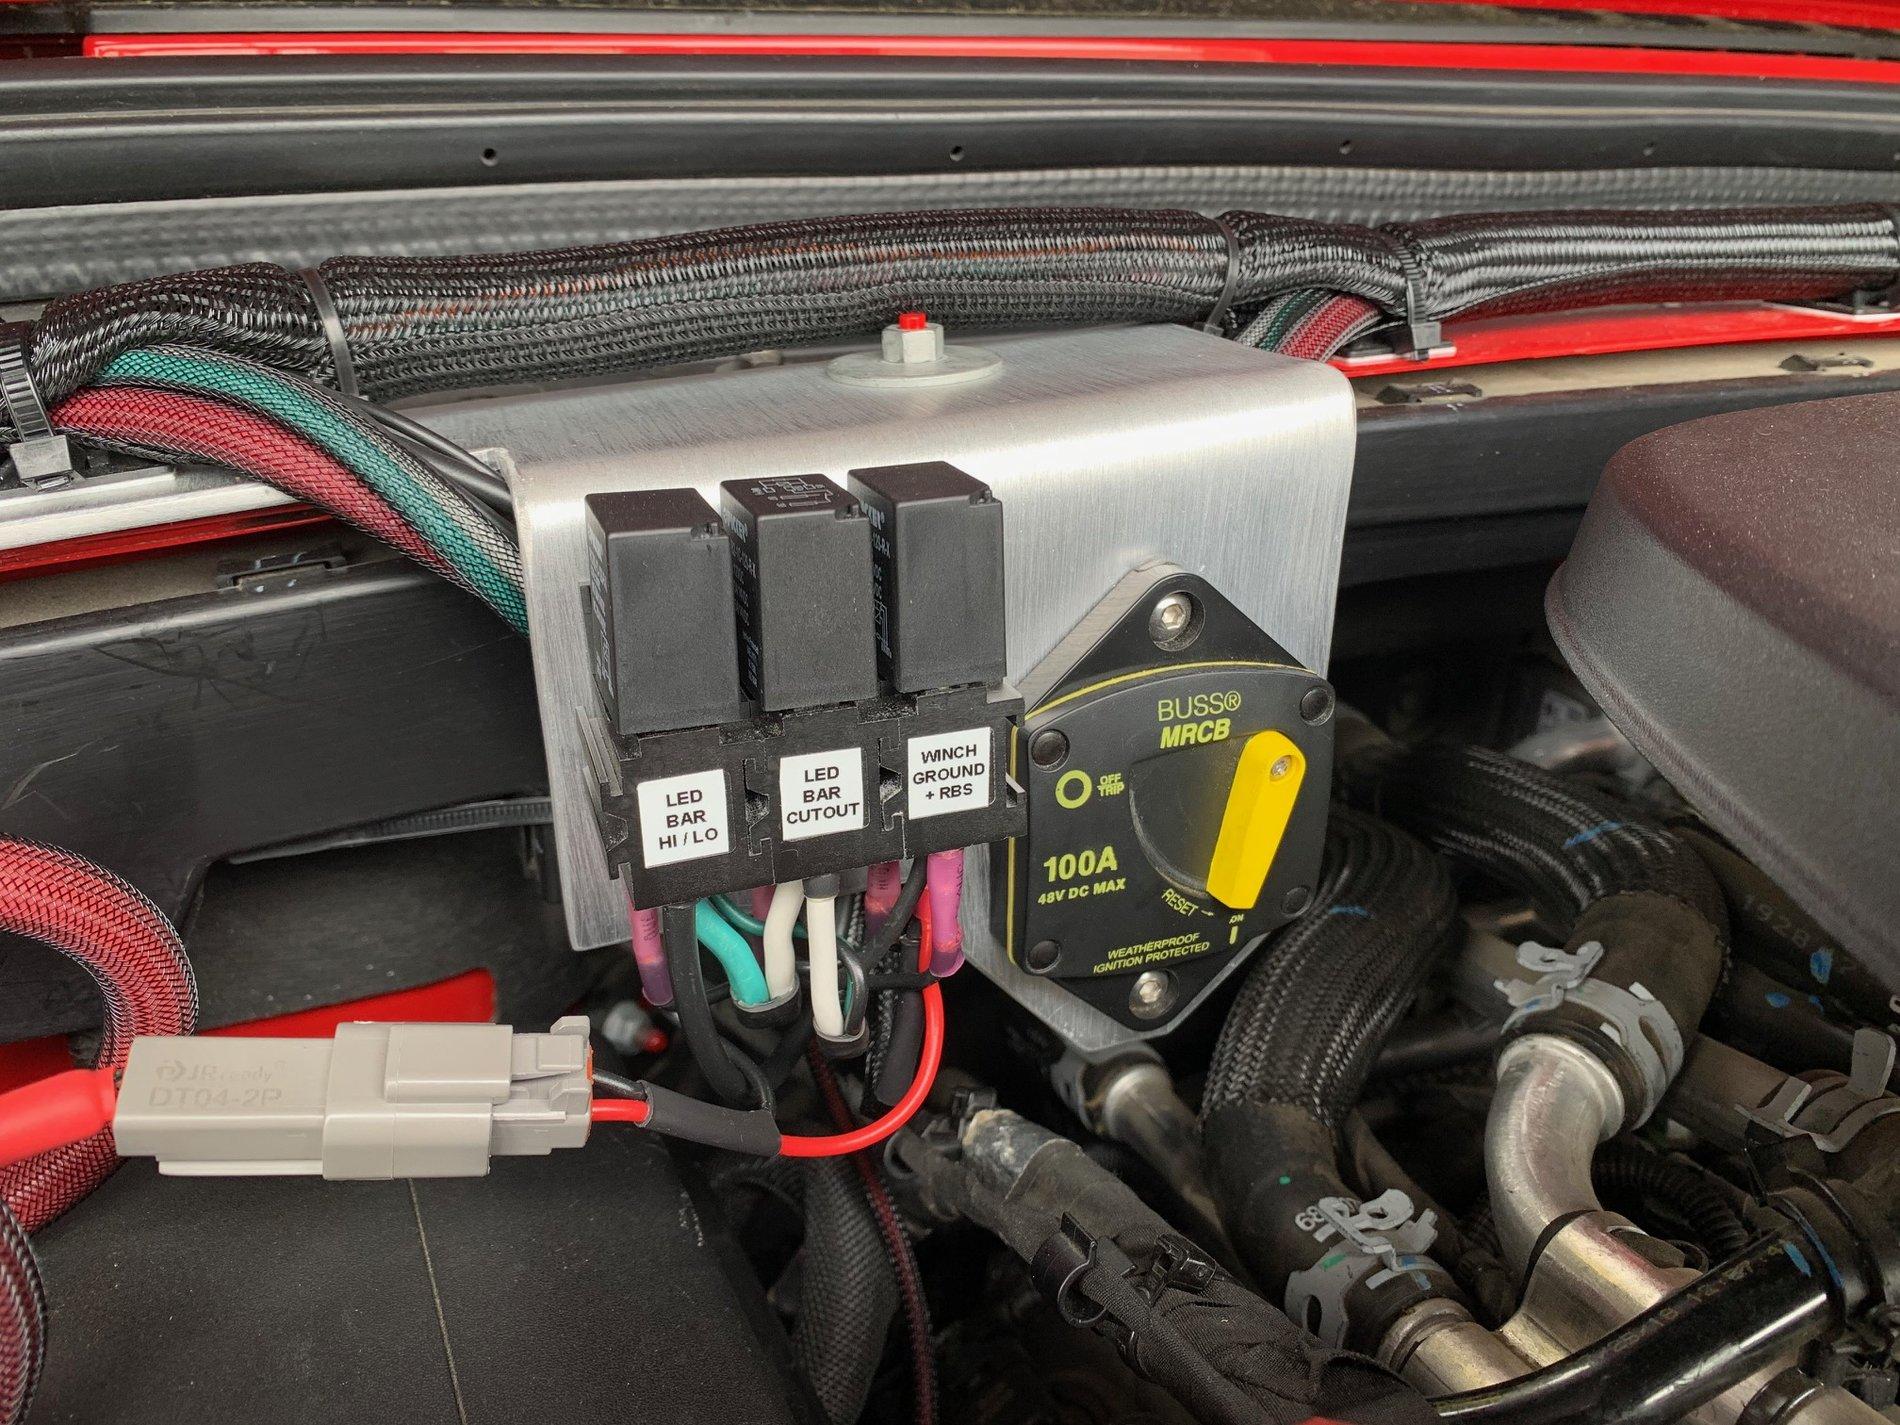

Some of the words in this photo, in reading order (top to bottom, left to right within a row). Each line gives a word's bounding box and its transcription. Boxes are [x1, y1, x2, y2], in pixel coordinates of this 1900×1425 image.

[1159, 718, 1232, 750] MRCB
[921, 744, 977, 763] WINCH
[804, 766, 840, 783] LED
[912, 762, 985, 785] GROUND
[1099, 772, 1122, 785] OFF
[666, 789, 703, 807] LED
[803, 786, 841, 804] BAR
[939, 782, 973, 800] RBS
[1097, 781, 1125, 797] TRIP
[666, 809, 706, 829] BAR
[786, 802, 860, 825] CUTOUT
[658, 834, 677, 850] HI
[692, 827, 719, 844] LO
[1043, 845, 1118, 882] 100A
[1038, 888, 1066, 905] 48V
[1068, 885, 1090, 899] DC
[1093, 878, 1126, 896] MAX
[1161, 888, 1199, 917] RESET
[1093, 952, 1148, 974] IGNITION
[1149, 941, 1210, 963] PROTECTED
[1107, 932, 1201, 961] WEATHERPROOF
[149, 1087, 283, 1108] DT04-2P
